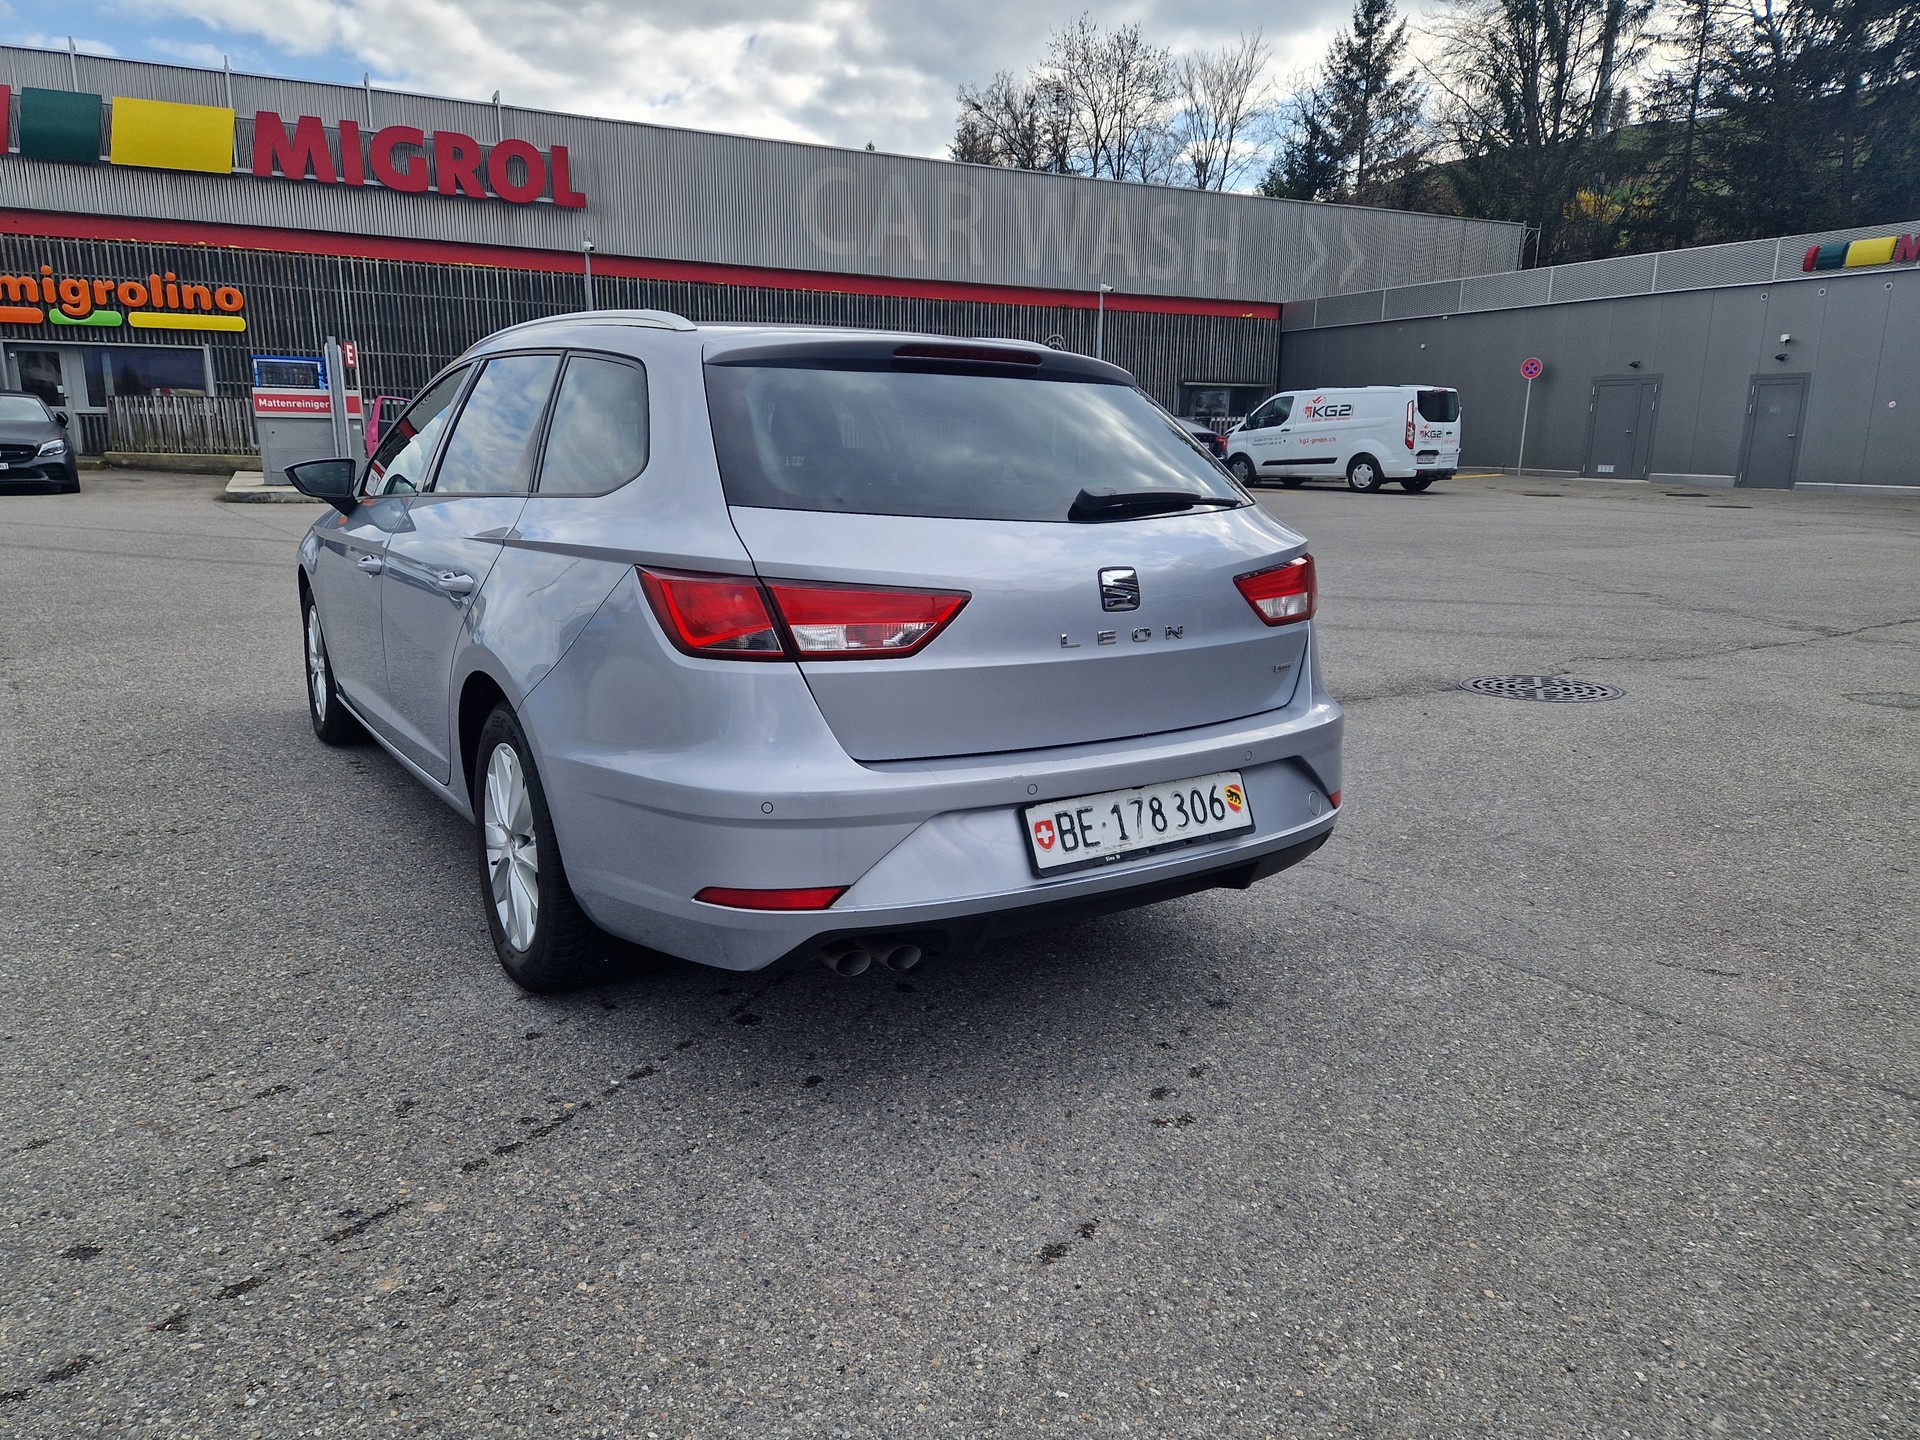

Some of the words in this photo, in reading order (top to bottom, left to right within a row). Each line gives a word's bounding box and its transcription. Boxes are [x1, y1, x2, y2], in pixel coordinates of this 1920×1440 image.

[253, 110, 587, 208] MIGROL
[801, 166, 984, 266] CAR
[1013, 188, 1241, 284] WASH
[0, 265, 244, 316] migrolino
[346, 344, 355, 365] E
[258, 398, 330, 410] Mattenreiniger
[1312, 404, 1352, 418] KG2
[1061, 624, 1184, 648] LEON
